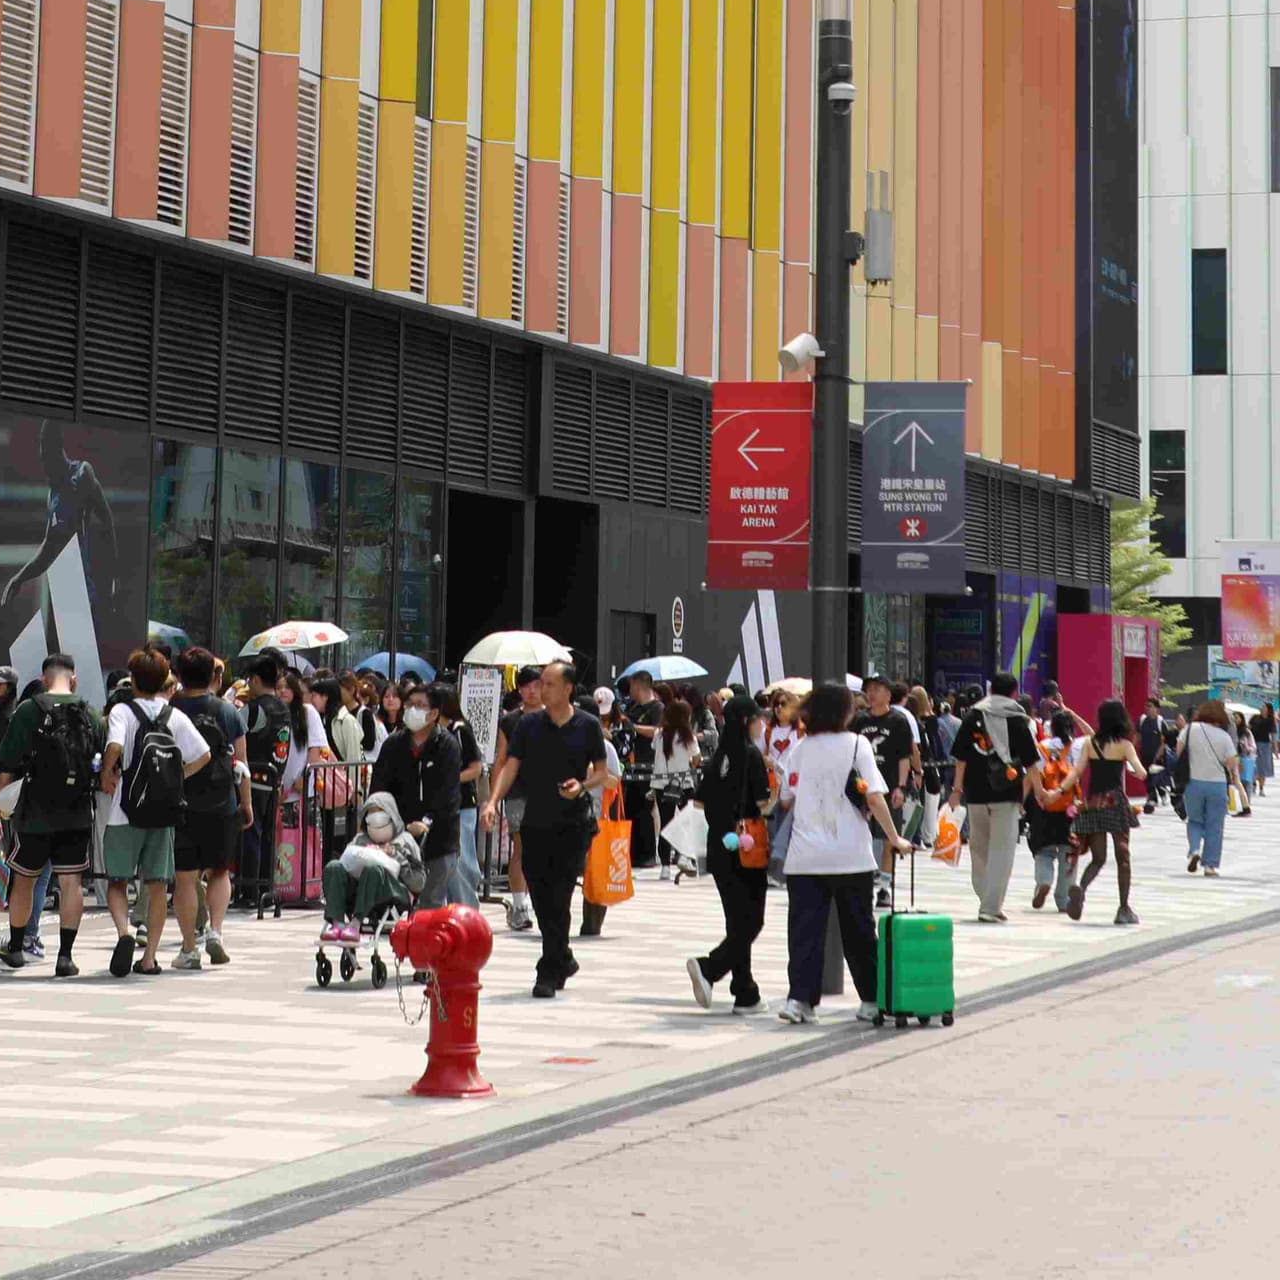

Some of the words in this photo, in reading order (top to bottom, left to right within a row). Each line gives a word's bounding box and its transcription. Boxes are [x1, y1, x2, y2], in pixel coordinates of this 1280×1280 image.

[879, 492, 902, 501] SUNG
[905, 492, 931, 501] WONG
[933, 492, 948, 501] TOI
[740, 504, 757, 514] KAI
[759, 504, 778, 514] TAK
[884, 503, 903, 512] MTR
[904, 503, 942, 512] STATION
[742, 517, 776, 528] ARENA
